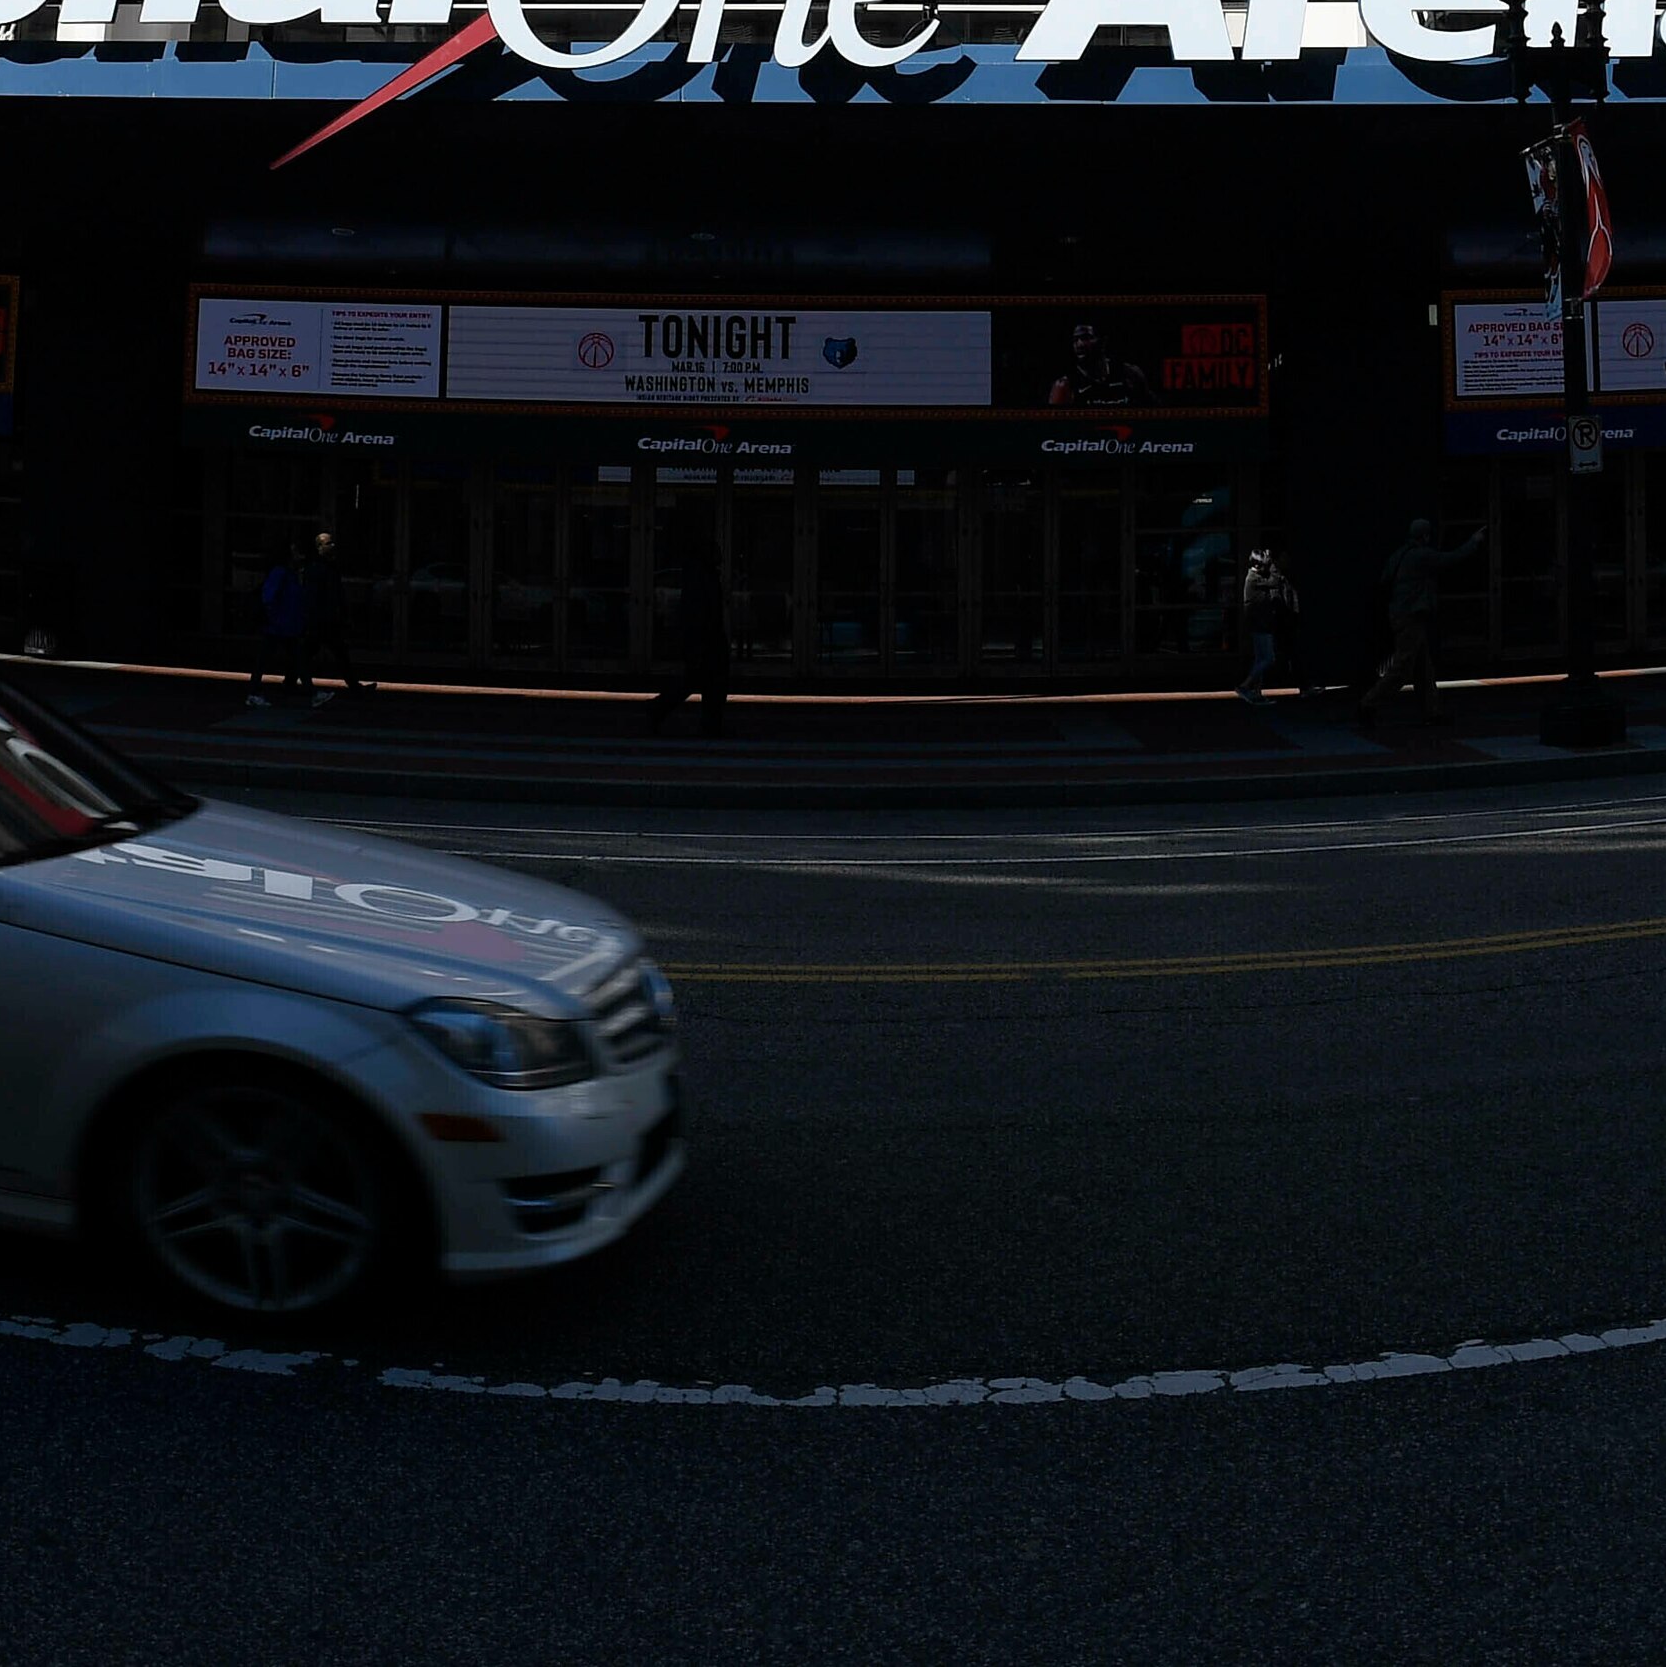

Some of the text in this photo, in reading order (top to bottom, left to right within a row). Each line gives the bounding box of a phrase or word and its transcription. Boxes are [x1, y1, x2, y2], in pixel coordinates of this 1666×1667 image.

[1468, 322, 1526, 333] APPROVED
[1529, 321, 1551, 332] BAG
[224, 336, 296, 348] APPROVED
[639, 315, 796, 359] TONIGHT
[228, 347, 292, 360] BAG SIZE:
[625, 375, 717, 393] WASHINGTON
[744, 377, 810, 394] MEMPHIS
[341, 432, 395, 446] Arena
[1600, 428, 1635, 439] rena
[735, 441, 793, 455] Arena
[1138, 440, 1195, 454] Arena
